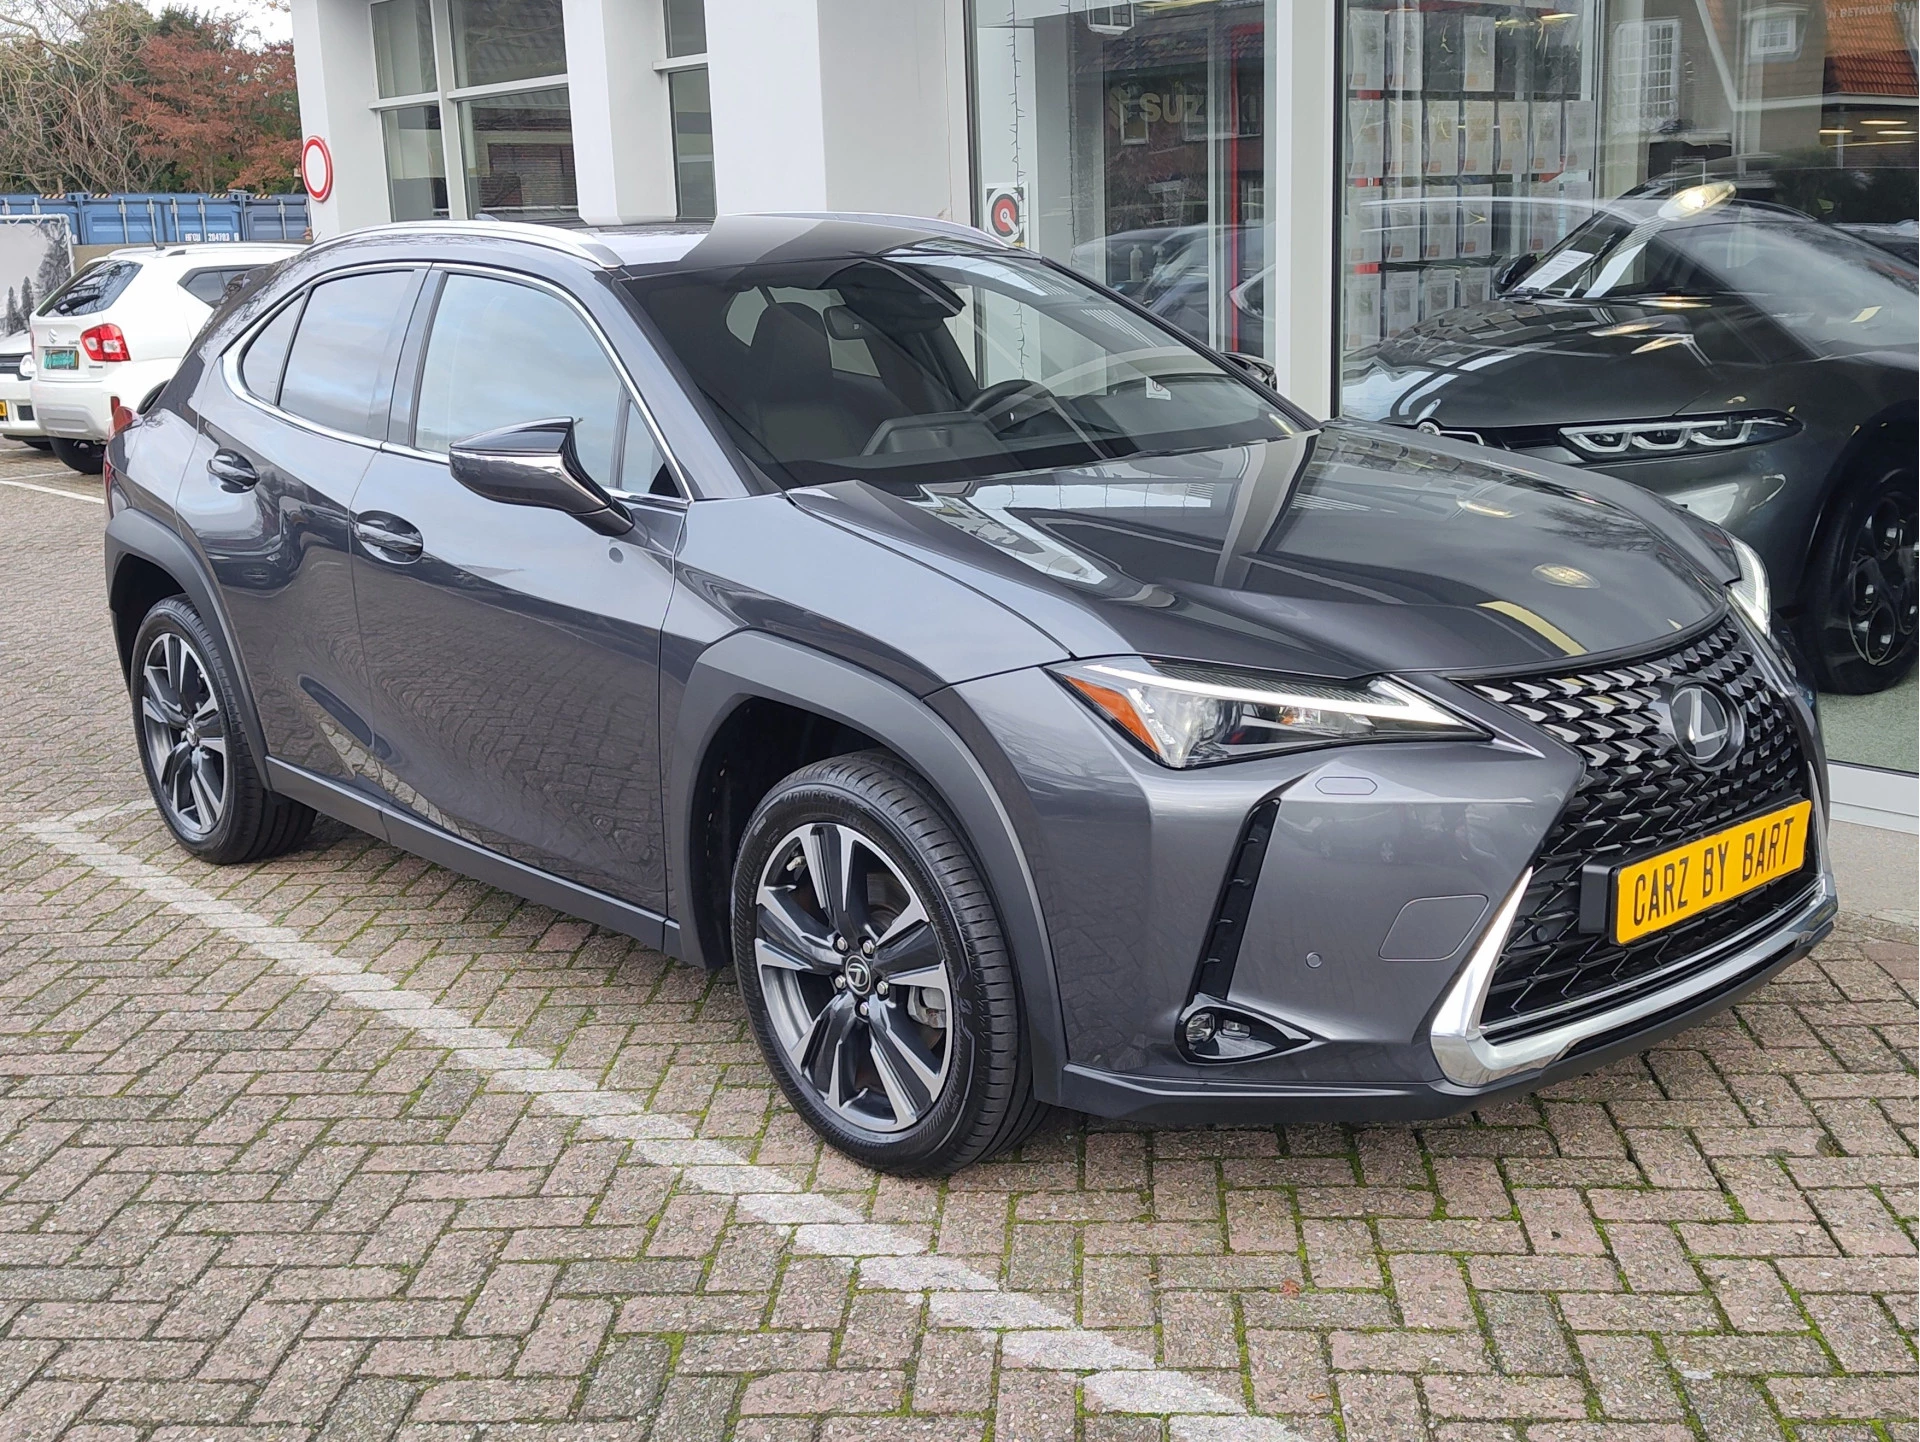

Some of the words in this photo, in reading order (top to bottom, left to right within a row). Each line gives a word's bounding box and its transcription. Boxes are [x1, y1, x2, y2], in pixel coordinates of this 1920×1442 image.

[1633, 856, 1689, 926] CARZ
[1702, 841, 1729, 898] BY
[1742, 816, 1795, 882] BART
